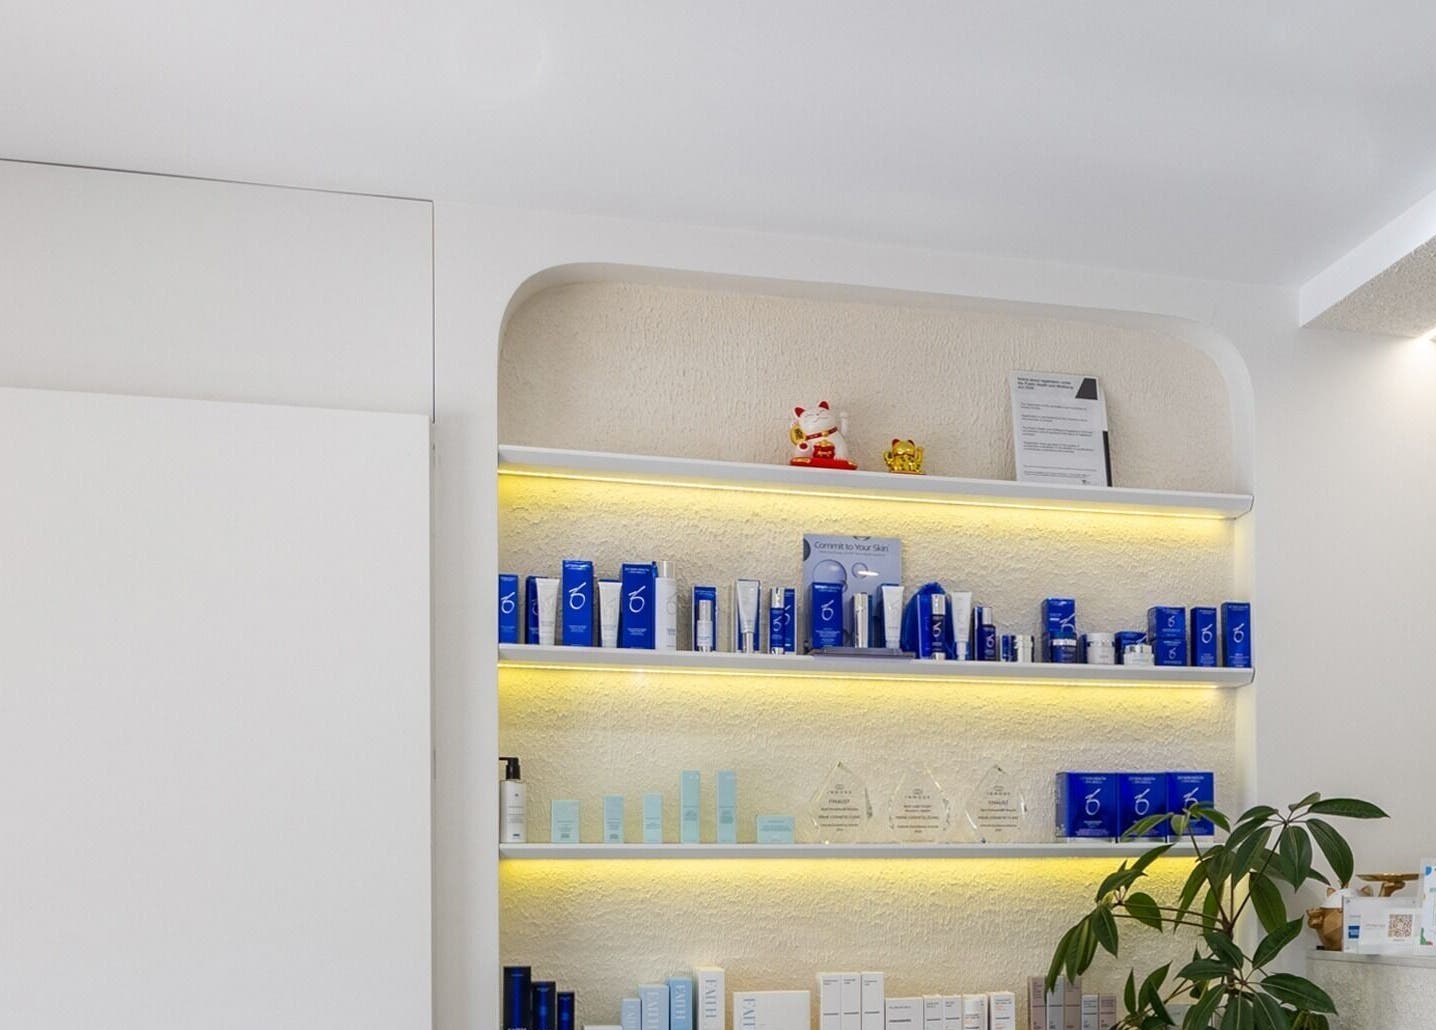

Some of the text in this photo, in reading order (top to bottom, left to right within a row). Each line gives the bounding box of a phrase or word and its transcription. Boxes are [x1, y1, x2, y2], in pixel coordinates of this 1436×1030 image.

[814, 541, 888, 552] Commit to Your Skin
[647, 991, 659, 1030] FAITH
[674, 984, 687, 1020] FAITH
[704, 978, 718, 1018] FAITH
